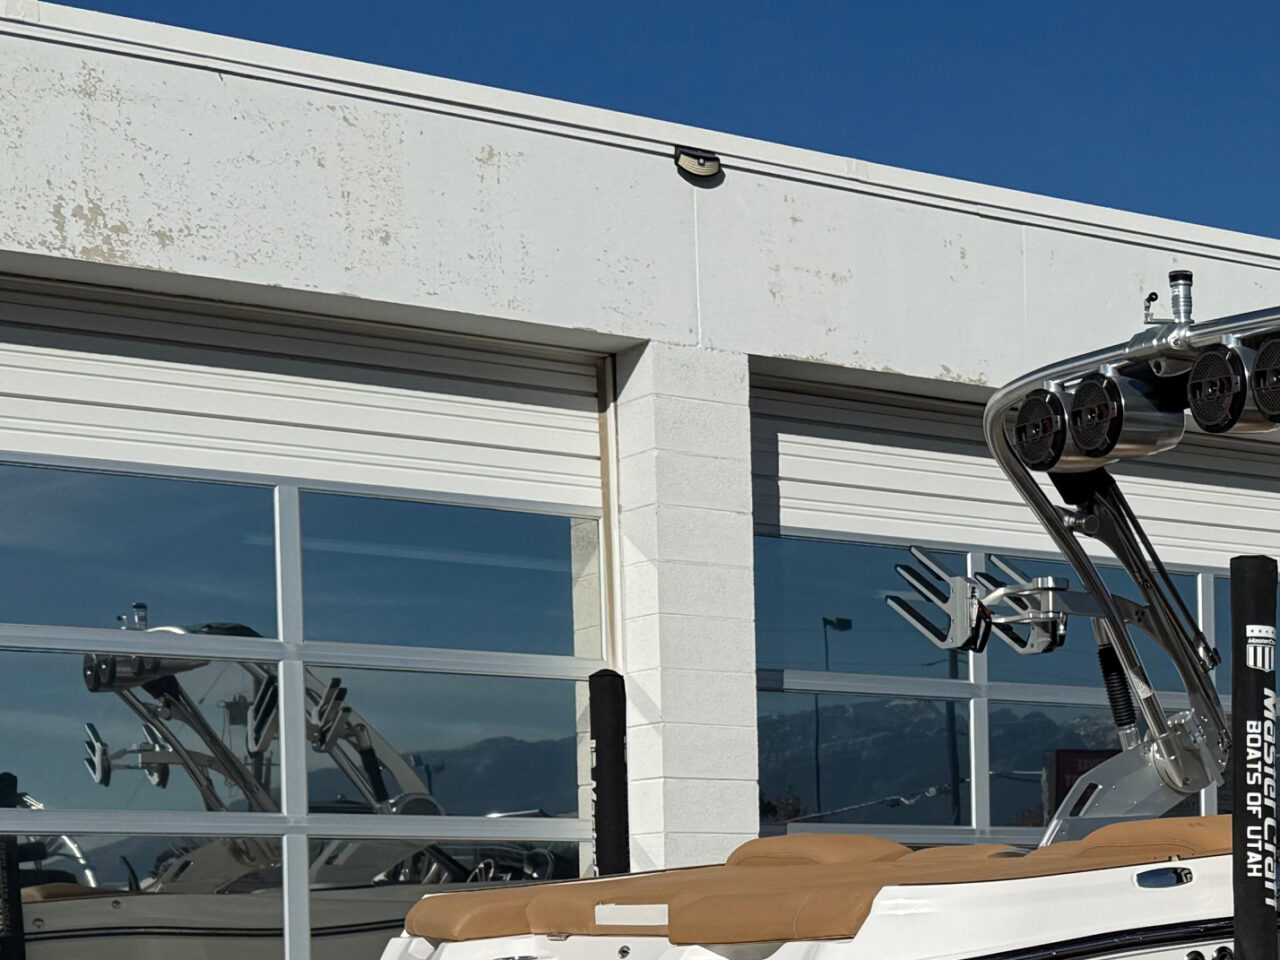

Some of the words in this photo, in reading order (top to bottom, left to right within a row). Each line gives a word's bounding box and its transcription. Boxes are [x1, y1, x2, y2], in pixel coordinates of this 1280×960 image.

[1246, 720, 1262, 785] BOATS
[1246, 792, 1262, 819] OF
[1246, 826, 1263, 877] UTAH
